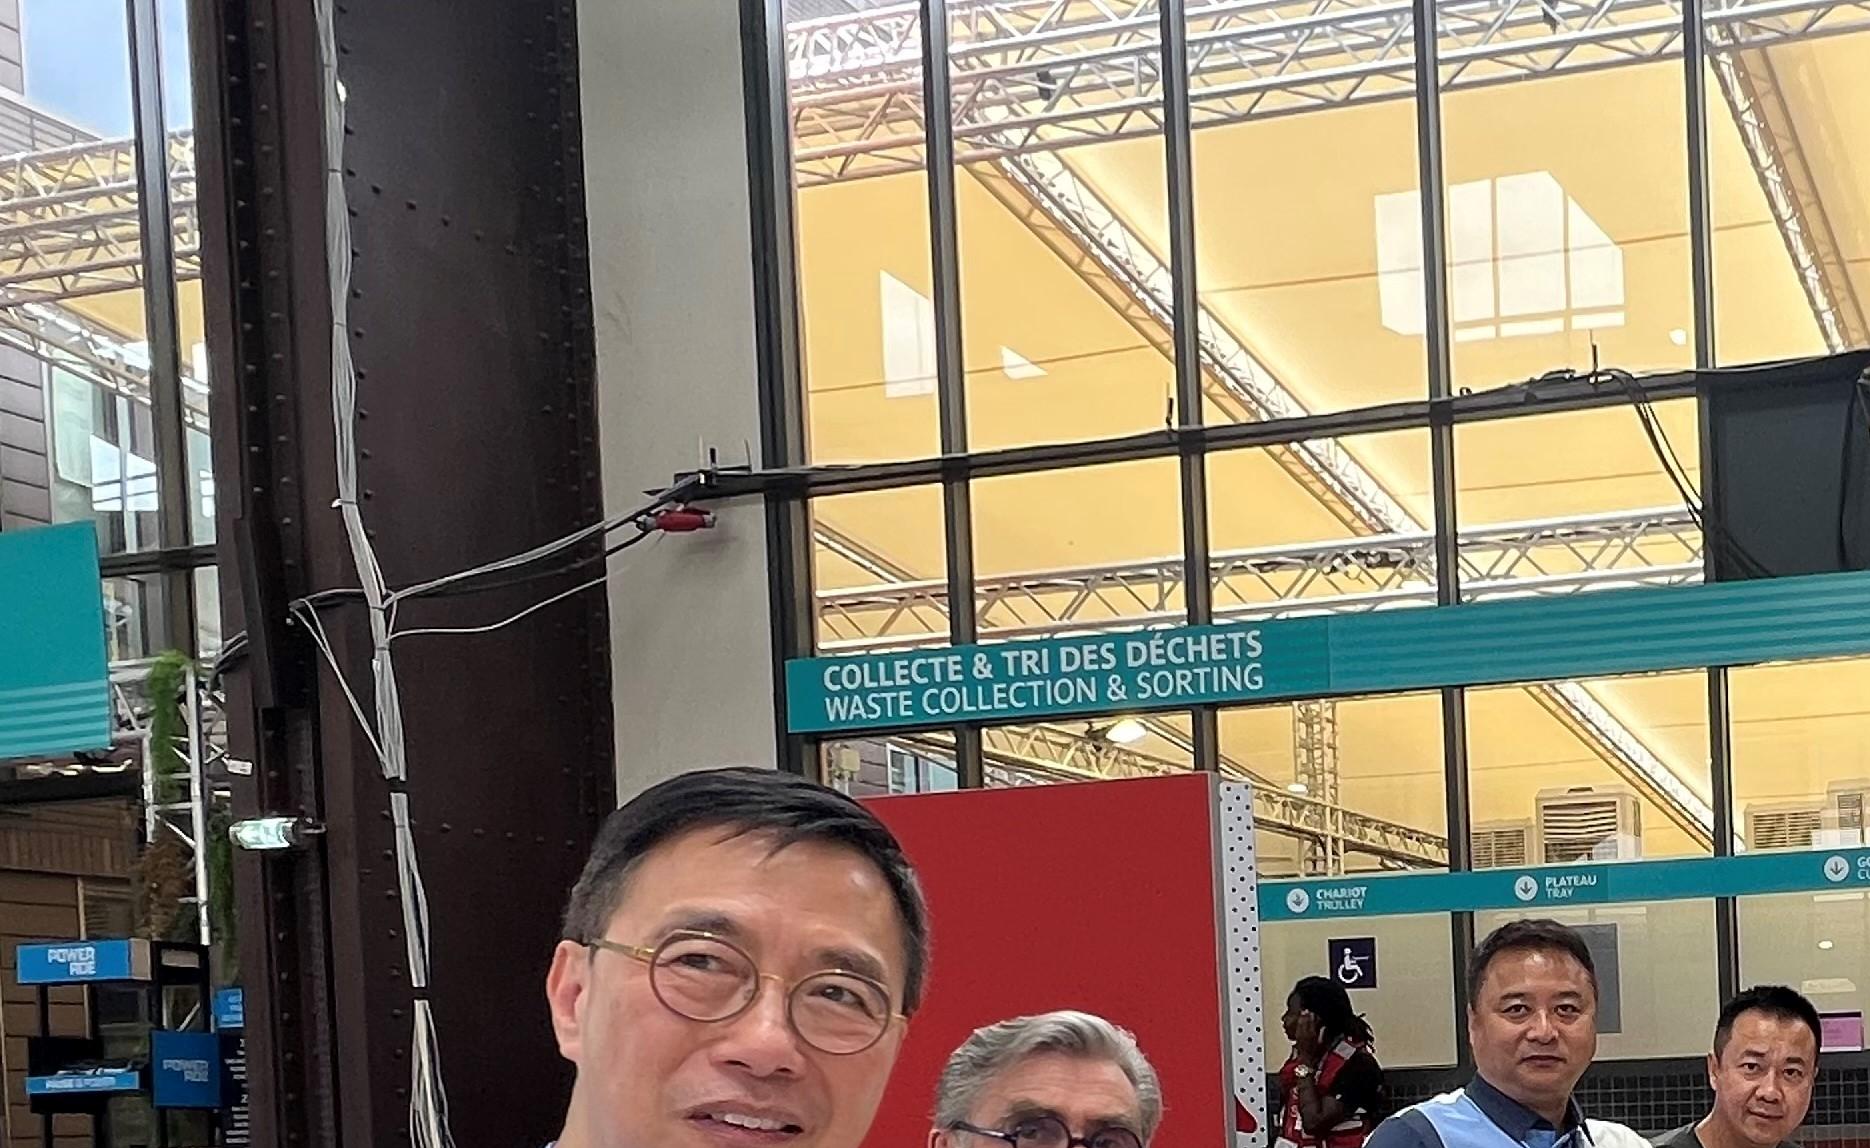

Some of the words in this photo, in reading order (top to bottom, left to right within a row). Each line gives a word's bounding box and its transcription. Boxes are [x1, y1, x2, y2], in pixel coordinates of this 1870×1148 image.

[823, 655, 964, 692] COLLECTE
[972, 653, 993, 679] &
[1001, 648, 1049, 677] TRI
[1059, 642, 1117, 673] DES
[1126, 630, 1263, 668] DÉCHETS
[824, 690, 914, 722] WASTE
[922, 676, 1097, 715] COLLECTION
[1107, 673, 1128, 701] &
[1137, 663, 1263, 699] SORTING
[1545, 874, 1597, 887] PLATEAU
[1316, 886, 1367, 900] CHARIOT
[1545, 887, 1574, 898] TRAY
[1316, 899, 1365, 910] TROLLEY
[47, 946, 96, 963] POWER
